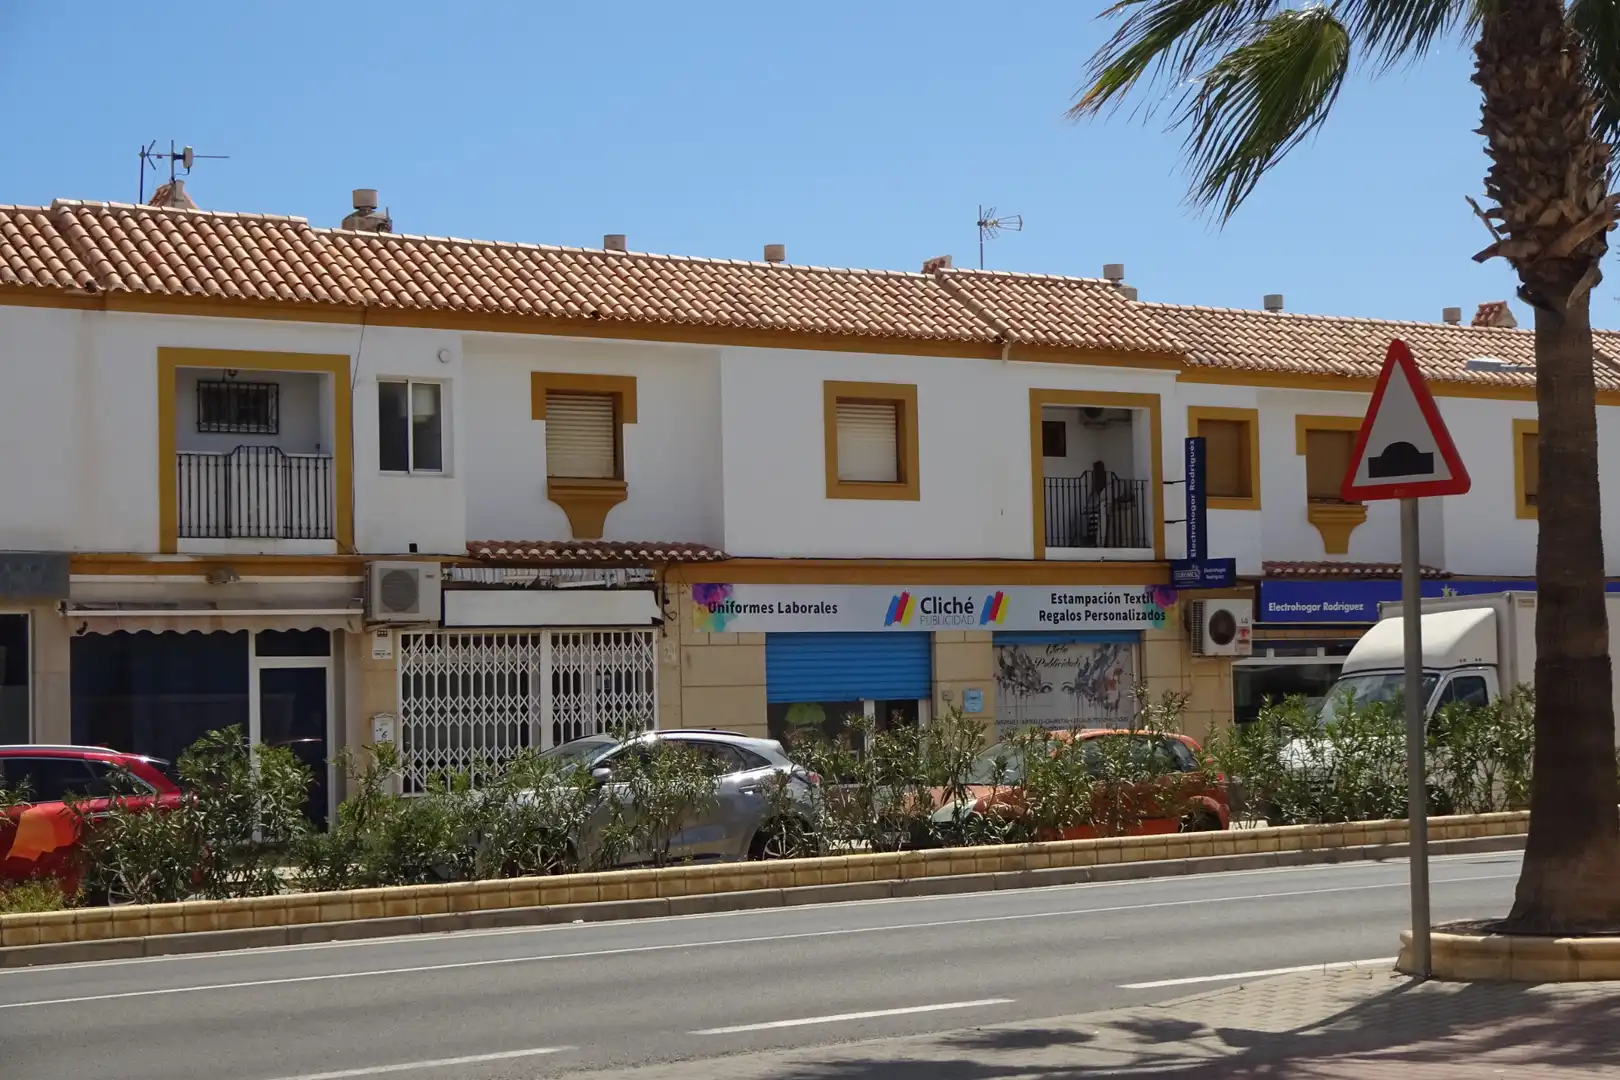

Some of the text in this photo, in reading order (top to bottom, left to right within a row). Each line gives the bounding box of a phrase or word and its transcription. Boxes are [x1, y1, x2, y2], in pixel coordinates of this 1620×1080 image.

[1188, 439, 1197, 558] Electrohogar Rodriguez
[920, 596, 974, 614] Cliché
[1050, 592, 1154, 606] Estampación Textil
[708, 601, 838, 614] Uniformes Laborales
[1268, 602, 1321, 613] Electrohogar
[1323, 602, 1364, 613] Rodriguez
[920, 614, 975, 625] PUBLICIDAD
[1039, 608, 1166, 624] Regalos Personalizados
